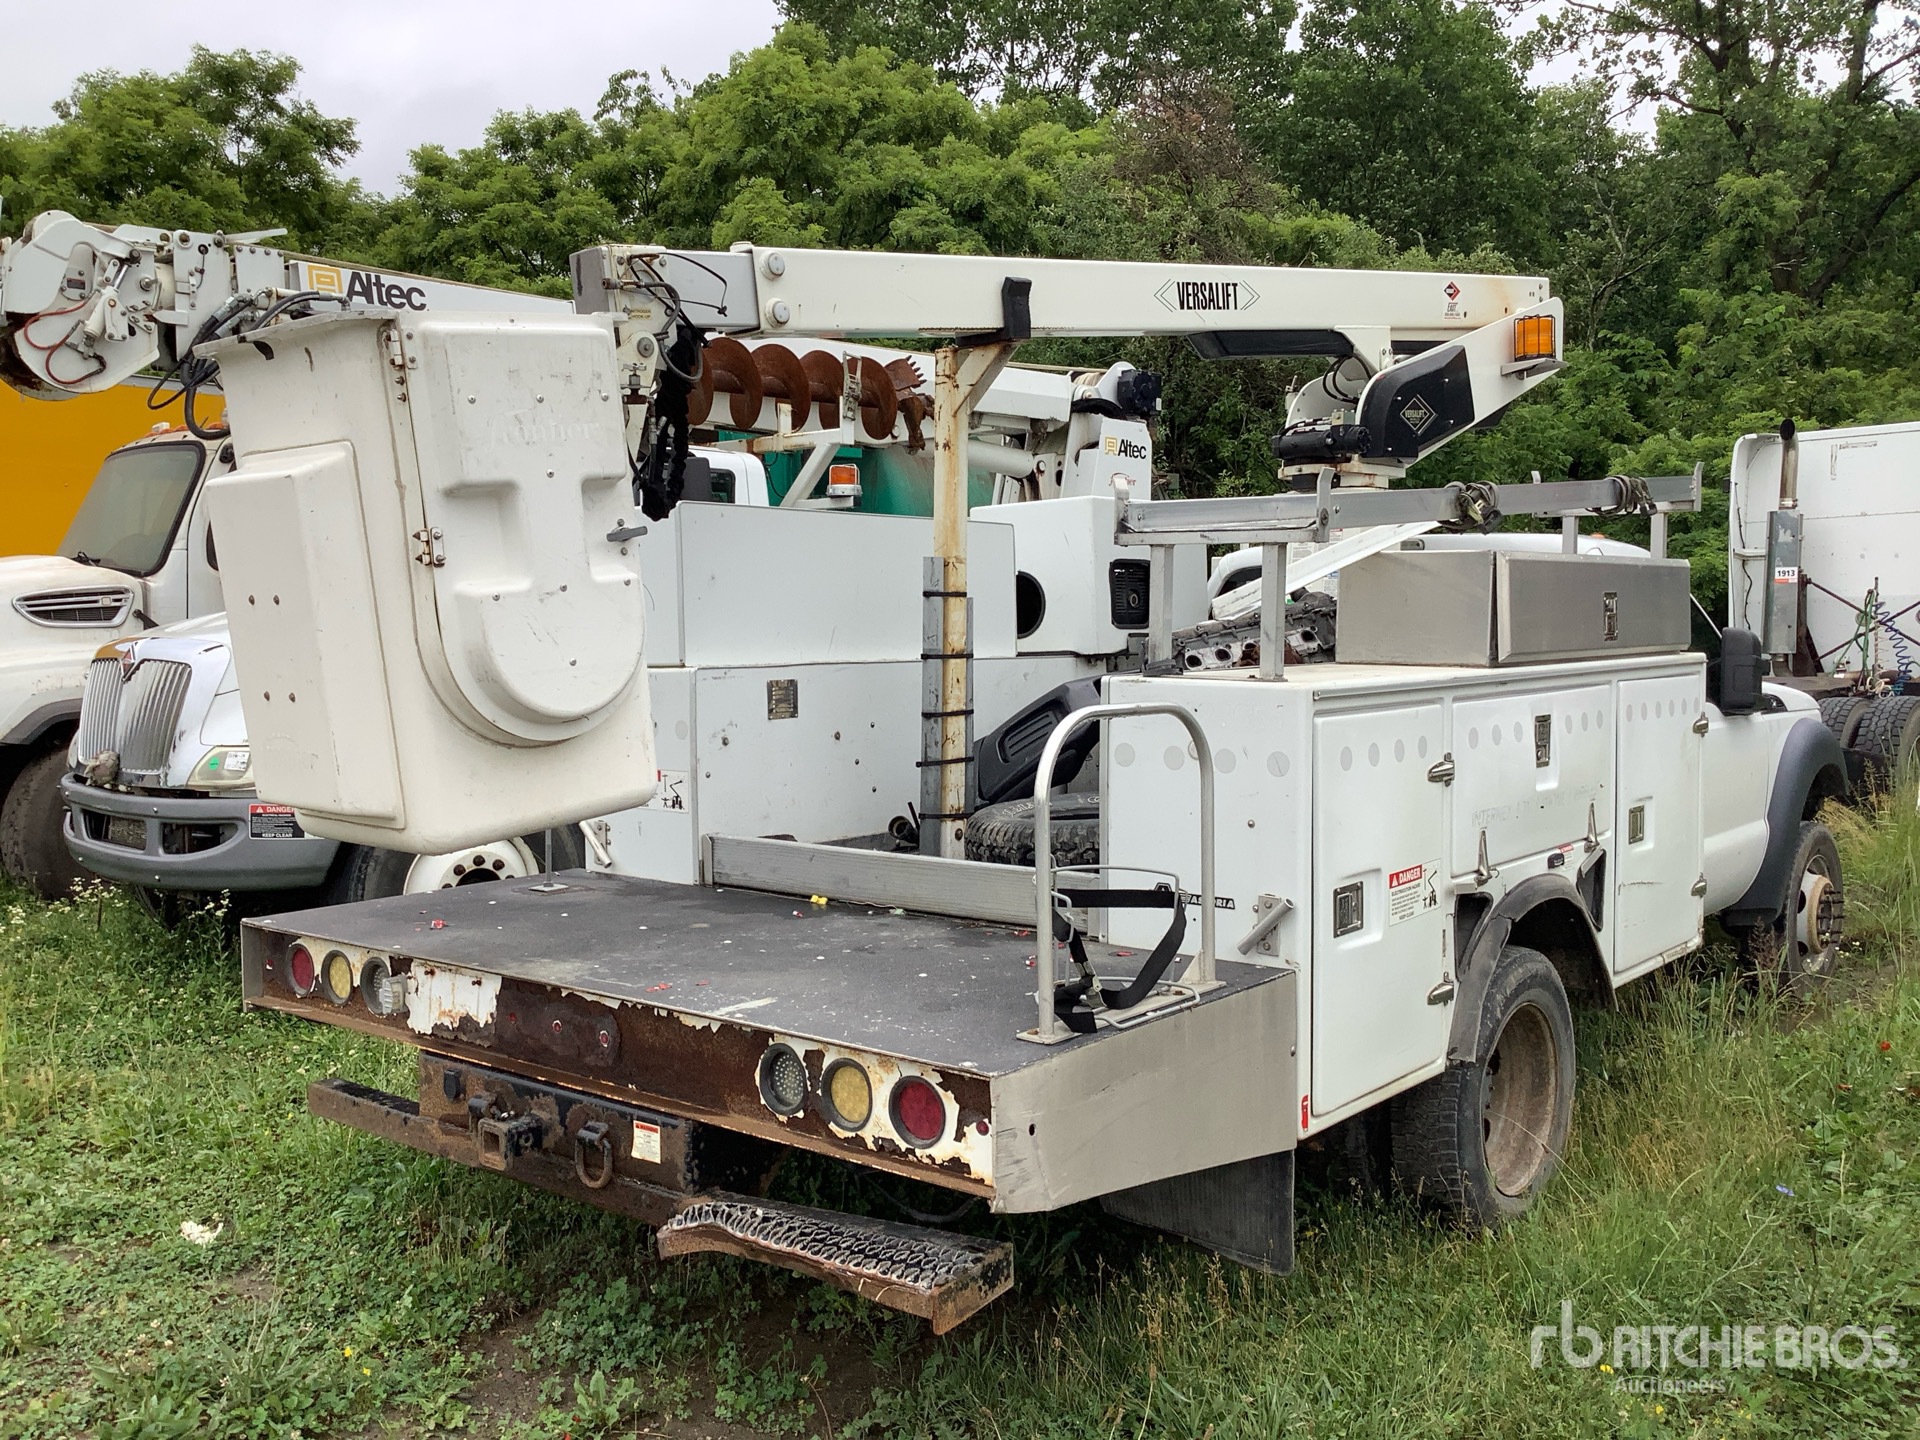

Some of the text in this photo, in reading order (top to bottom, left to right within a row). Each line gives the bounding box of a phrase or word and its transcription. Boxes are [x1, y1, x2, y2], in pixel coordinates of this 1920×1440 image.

[347, 271, 426, 311] Altec
[1177, 281, 1238, 310] VERSALIFT
[1404, 409, 1425, 418] VERSALIFT
[1118, 438, 1147, 459] Altec
[1399, 867, 1421, 884] DANGER
[1191, 896, 1235, 909] ASRIA
